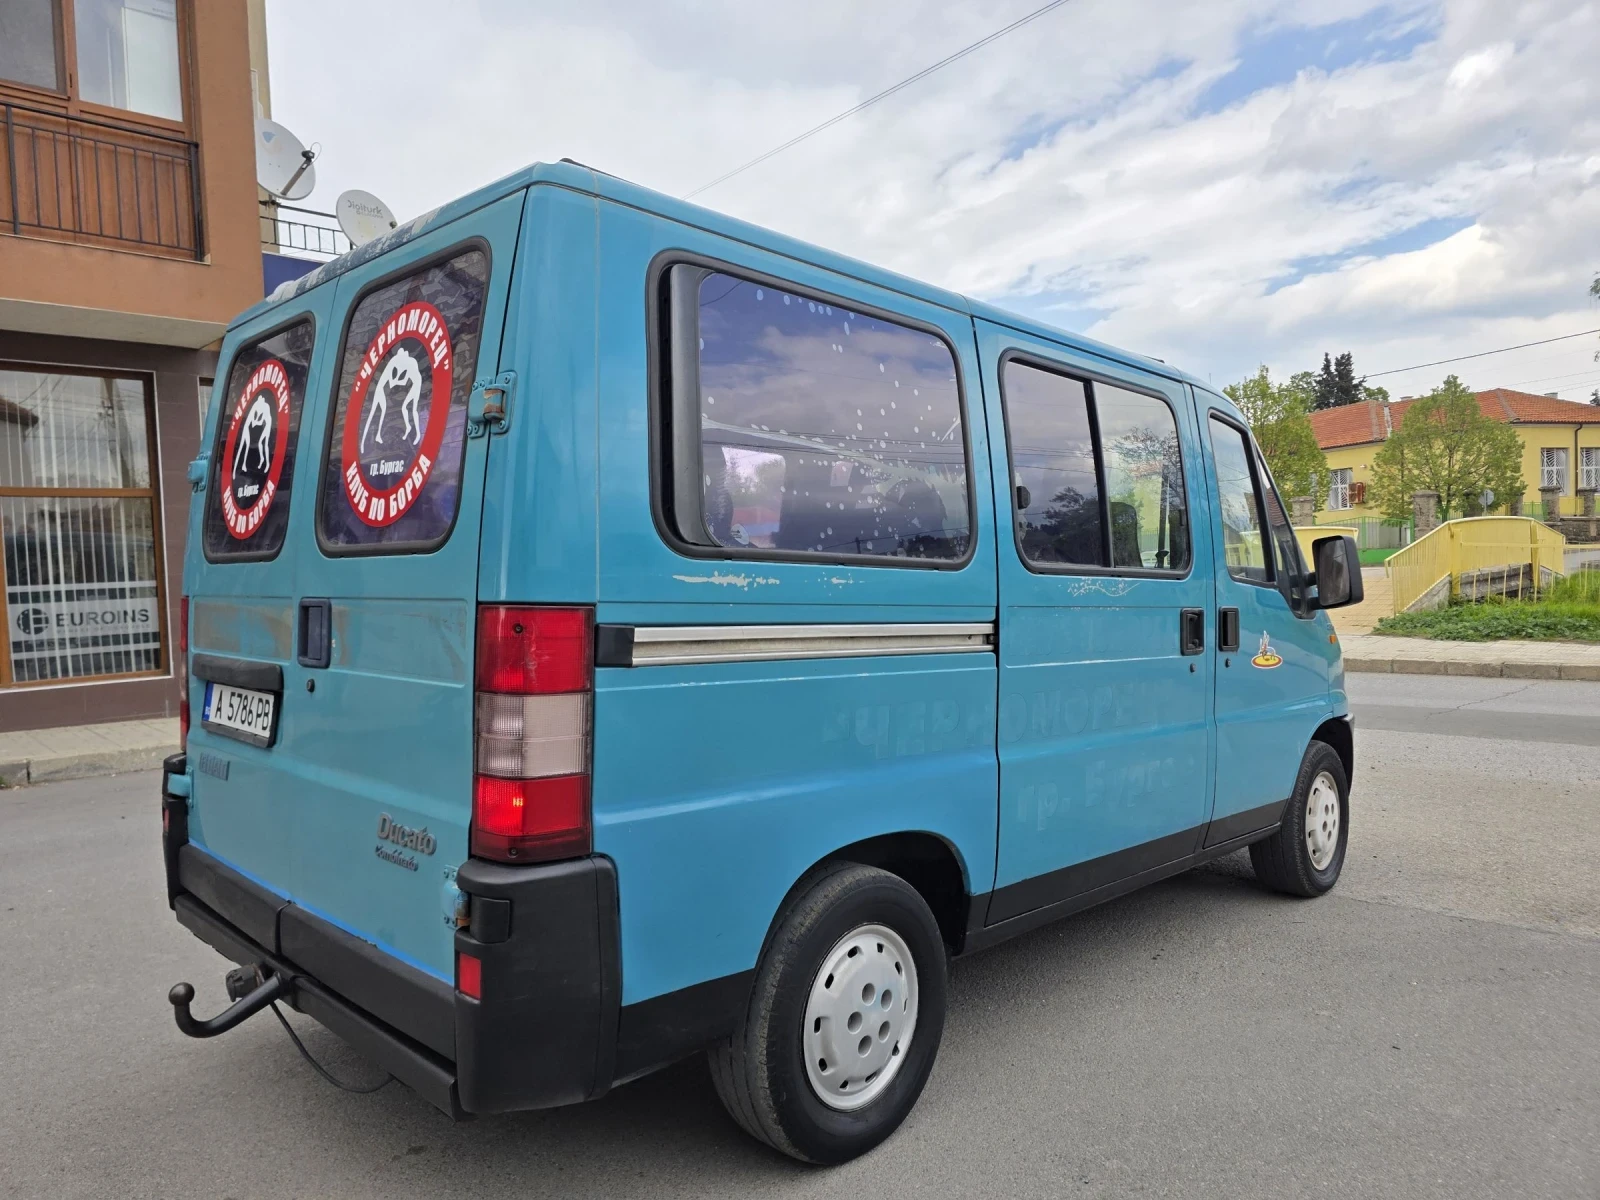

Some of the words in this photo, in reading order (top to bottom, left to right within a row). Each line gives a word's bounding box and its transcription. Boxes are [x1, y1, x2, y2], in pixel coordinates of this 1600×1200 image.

[346, 461, 369, 513] КЛУБ
[368, 497, 385, 521] ПО
[389, 454, 431, 518] БОРБА
[379, 459, 405, 475] Бургас
[56, 608, 149, 627] EUROINS
[214, 690, 223, 719] A
[227, 691, 255, 727] 5786
[254, 697, 271, 731] PB
[377, 812, 437, 856] Ducato
